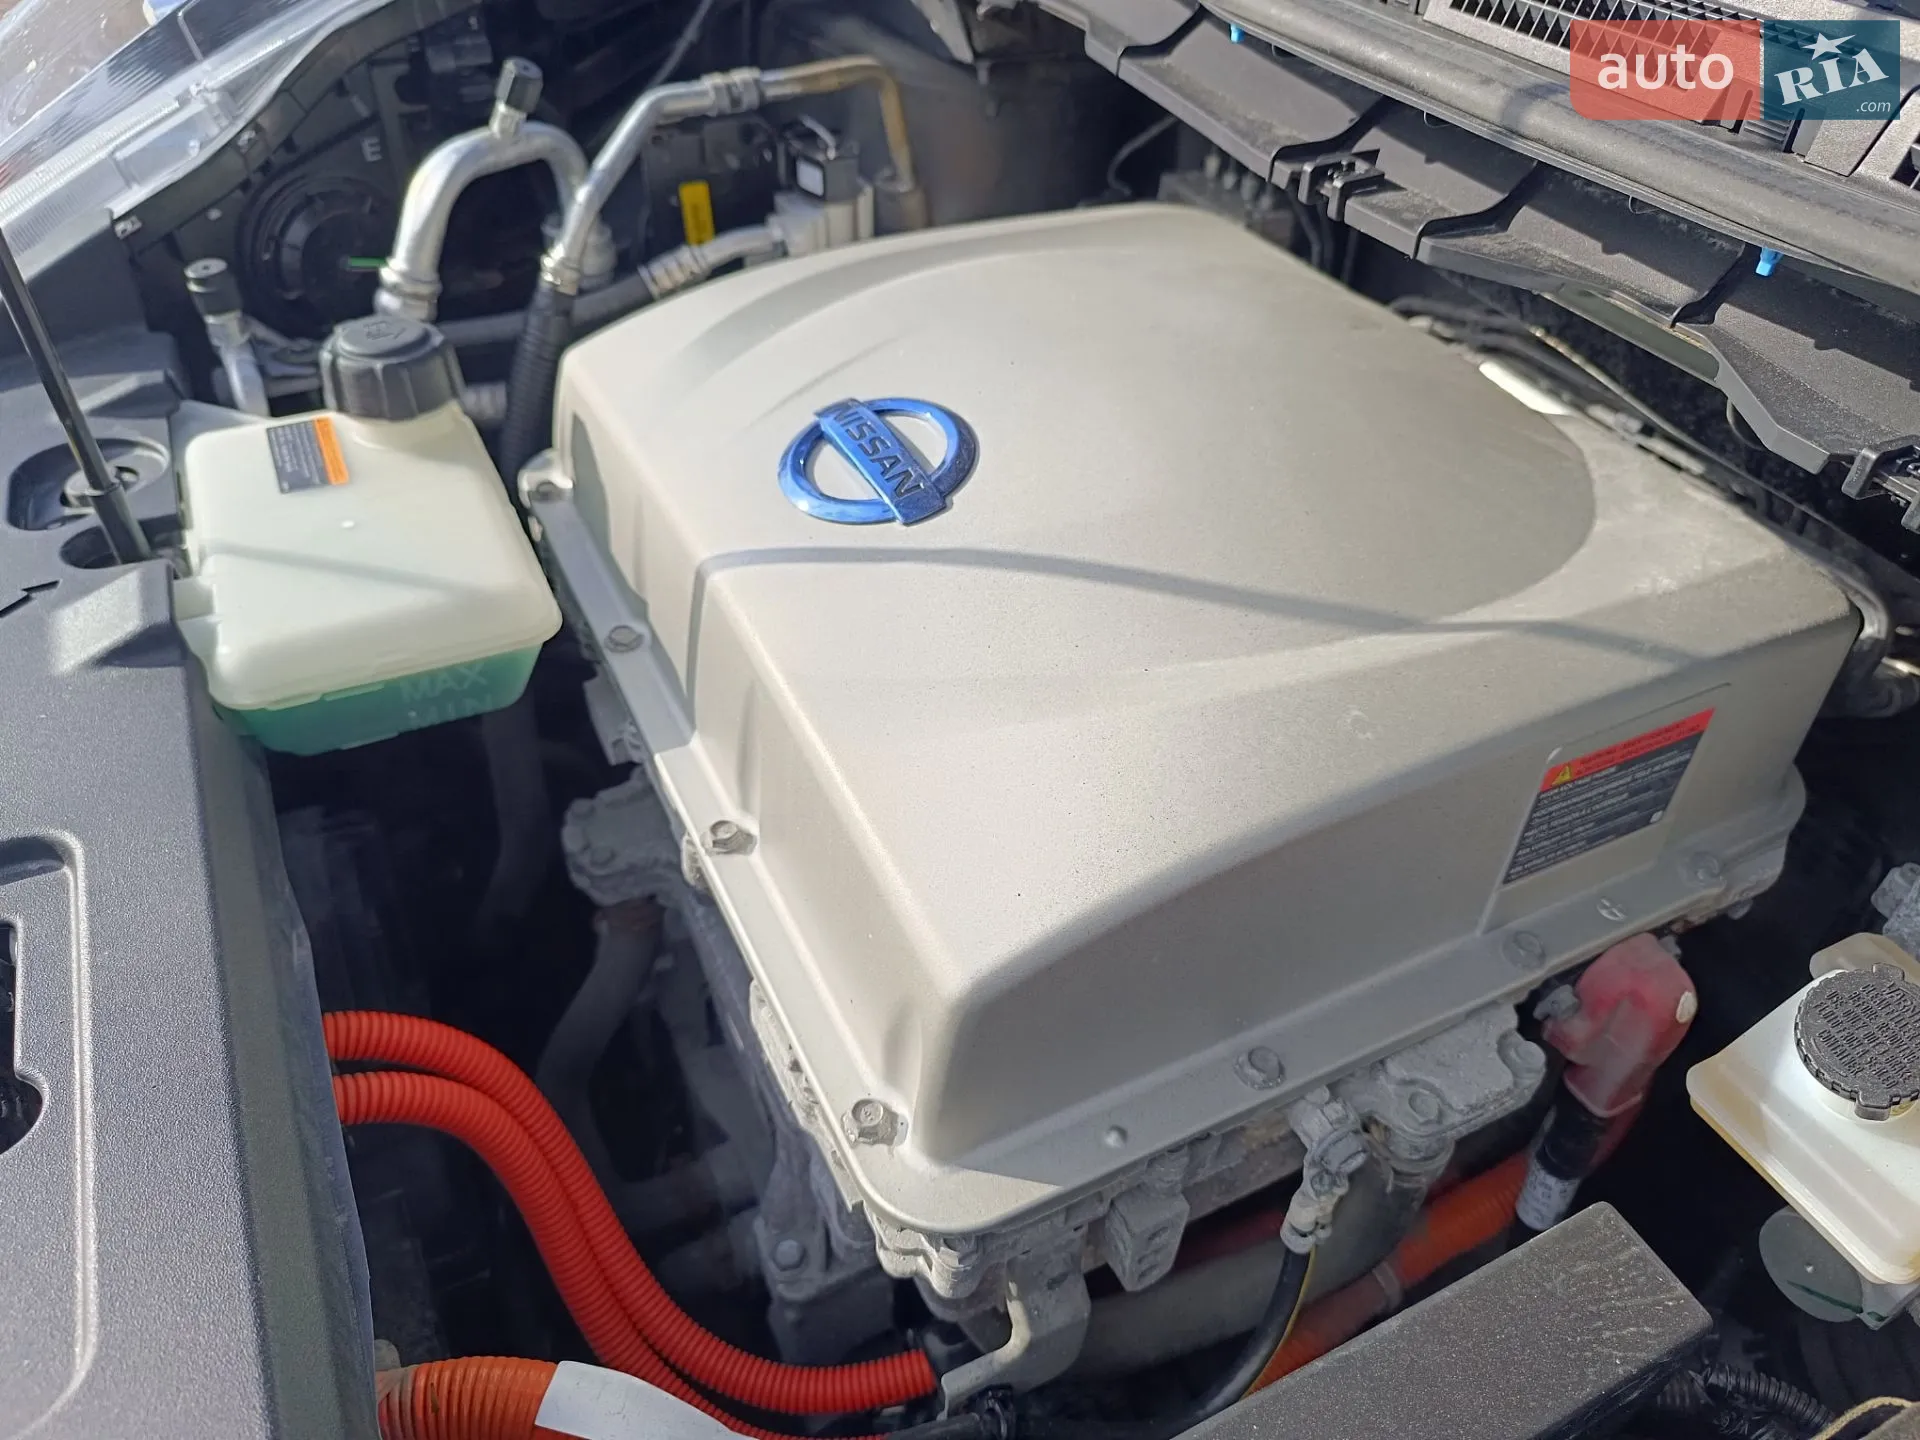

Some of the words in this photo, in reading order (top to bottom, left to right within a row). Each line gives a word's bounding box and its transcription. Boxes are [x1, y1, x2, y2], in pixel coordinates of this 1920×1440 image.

[829, 402, 926, 498] NISSAN
[400, 662, 488, 703] MAX
[1825, 989, 1846, 1009] USE
[1842, 1006, 1867, 1030] ONLY
[1883, 1054, 1911, 1083] BRAKE
[1847, 990, 1879, 1024] BEFORE
[1860, 984, 1890, 1010] CLEAN
[1884, 1007, 1918, 1042] FILLER
[1812, 1000, 1842, 1028] FLUID
[1836, 1025, 1862, 1050] FROM
[1866, 1056, 1898, 1089] SEALED
[1816, 1028, 1864, 1078] CONTAINER
